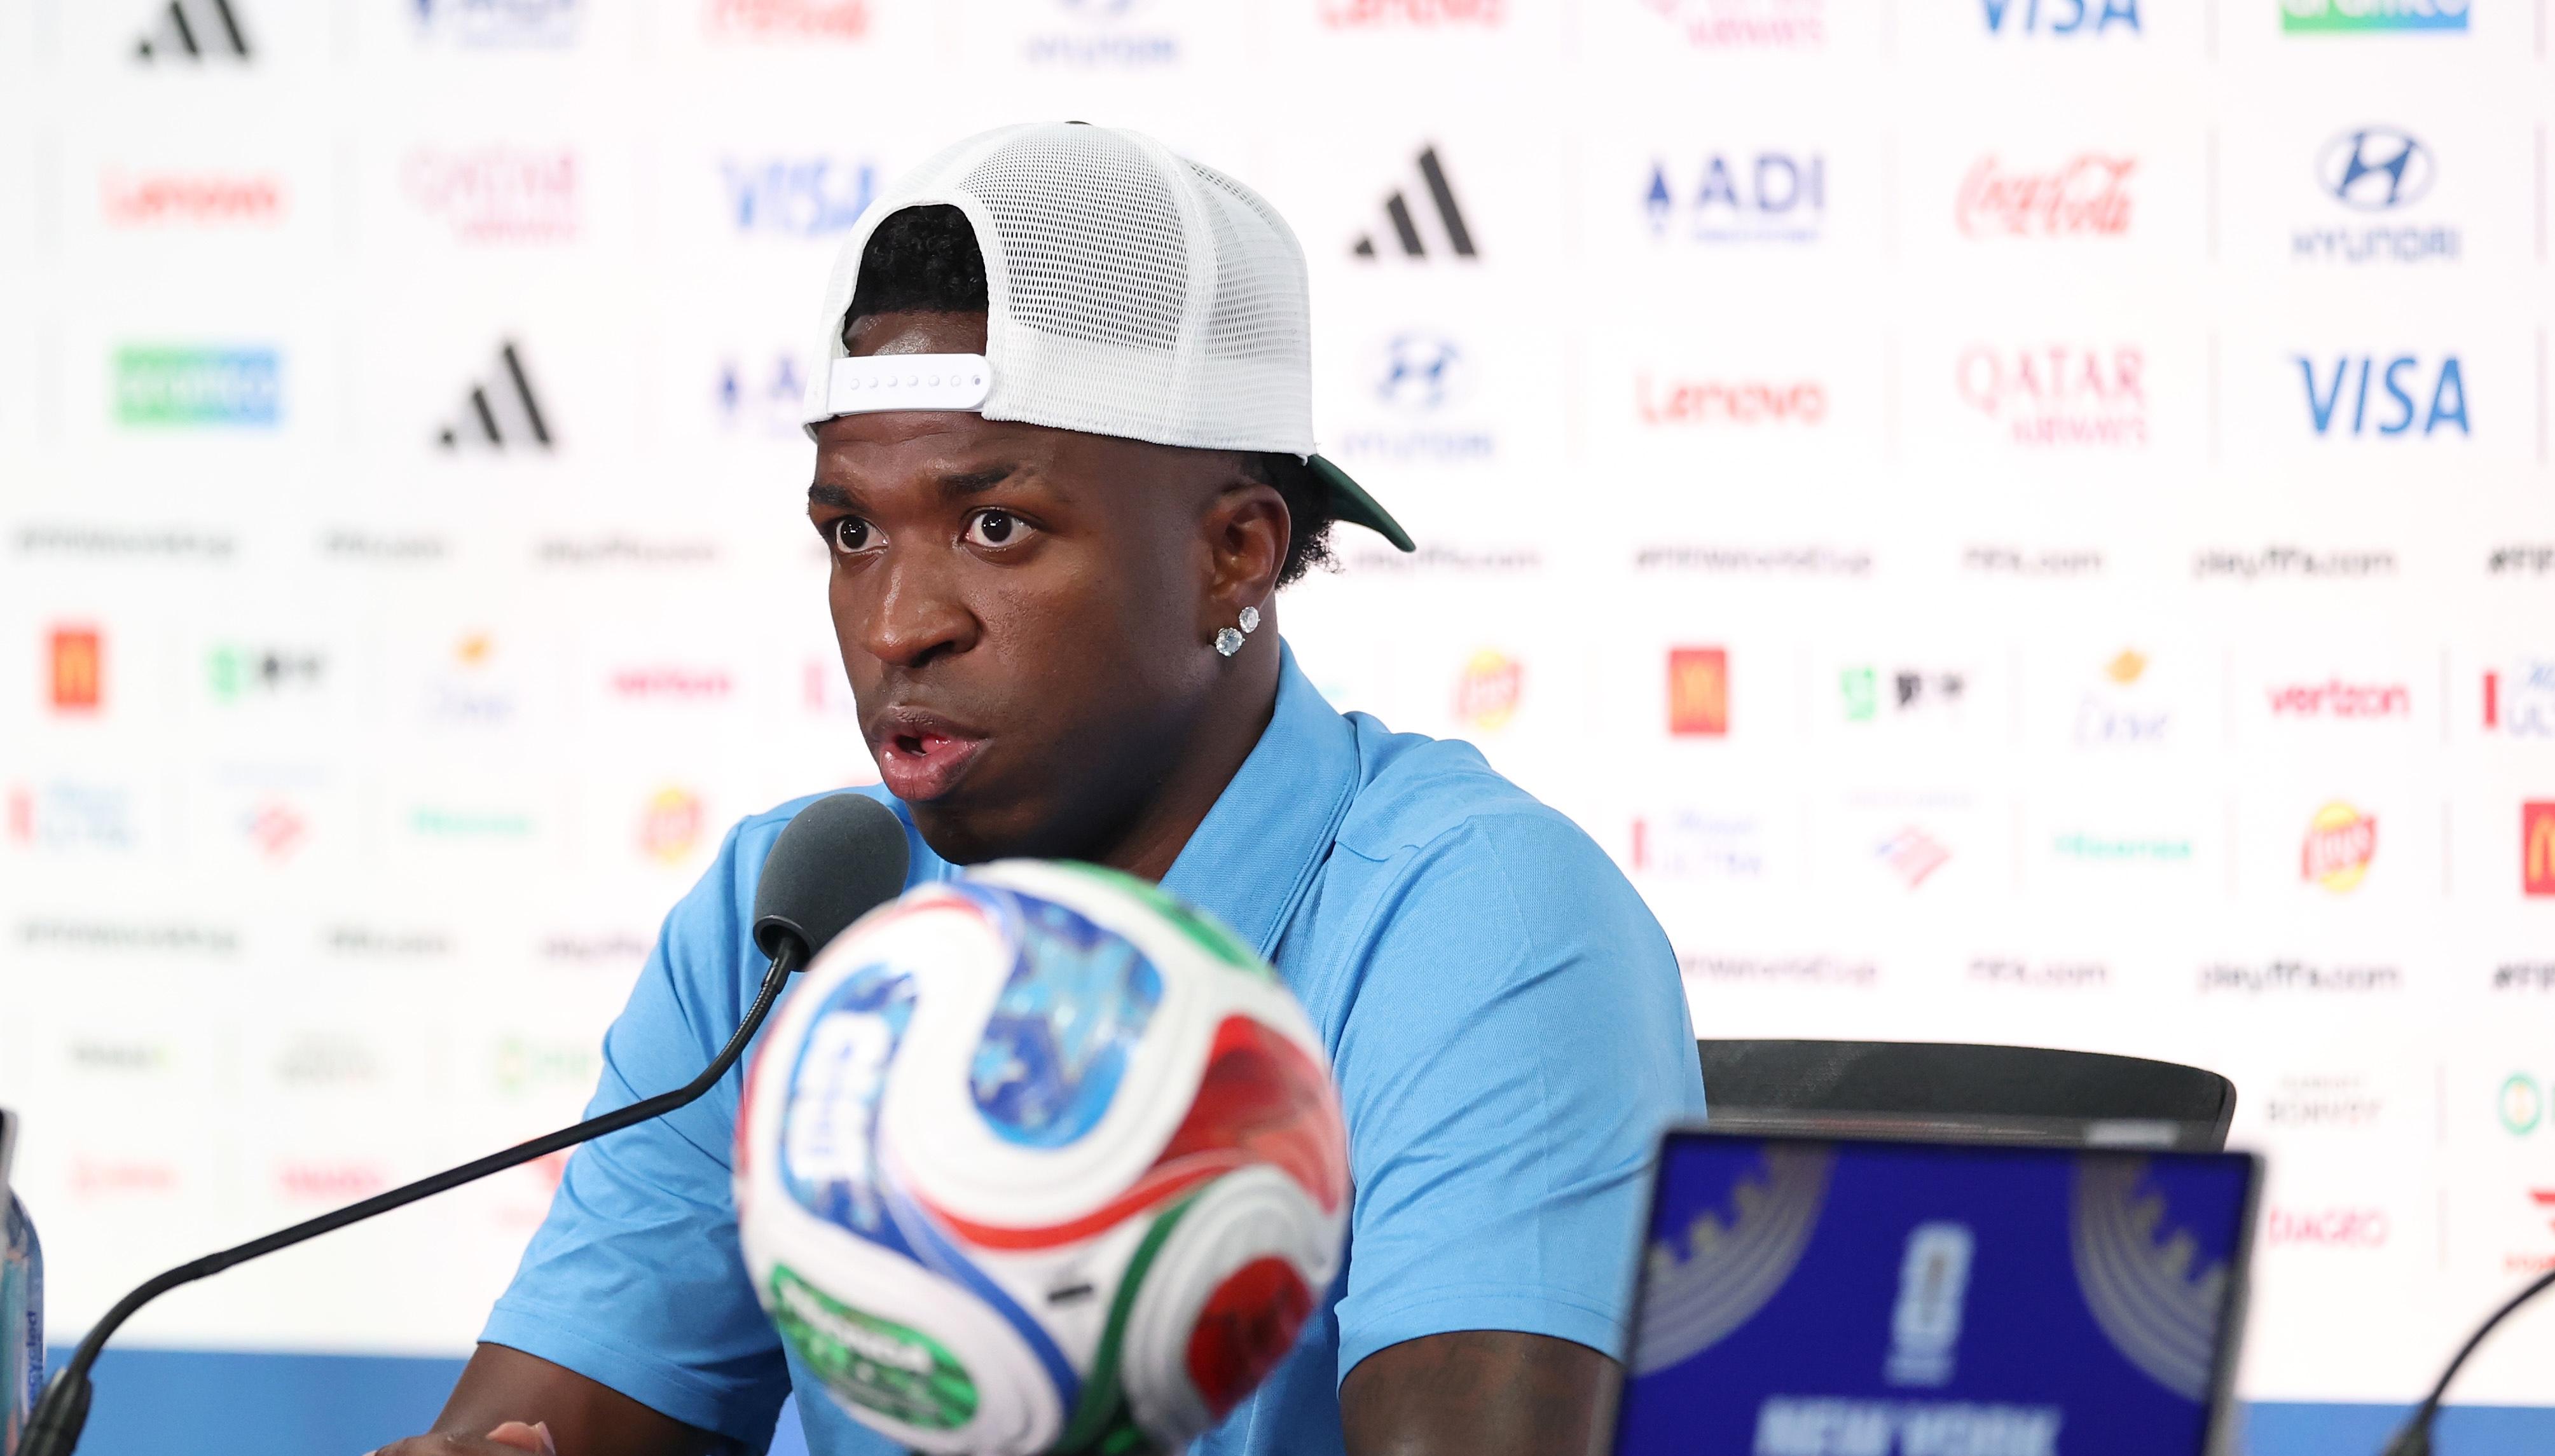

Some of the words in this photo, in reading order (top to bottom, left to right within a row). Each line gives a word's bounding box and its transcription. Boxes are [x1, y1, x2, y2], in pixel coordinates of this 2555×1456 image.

[1694, 154, 1825, 212] ADI
[1636, 370, 1828, 426] Lenovo
[1956, 343, 2145, 416] QATAR
[2289, 353, 2472, 439] VISA
[2269, 678, 2410, 718] verizon
